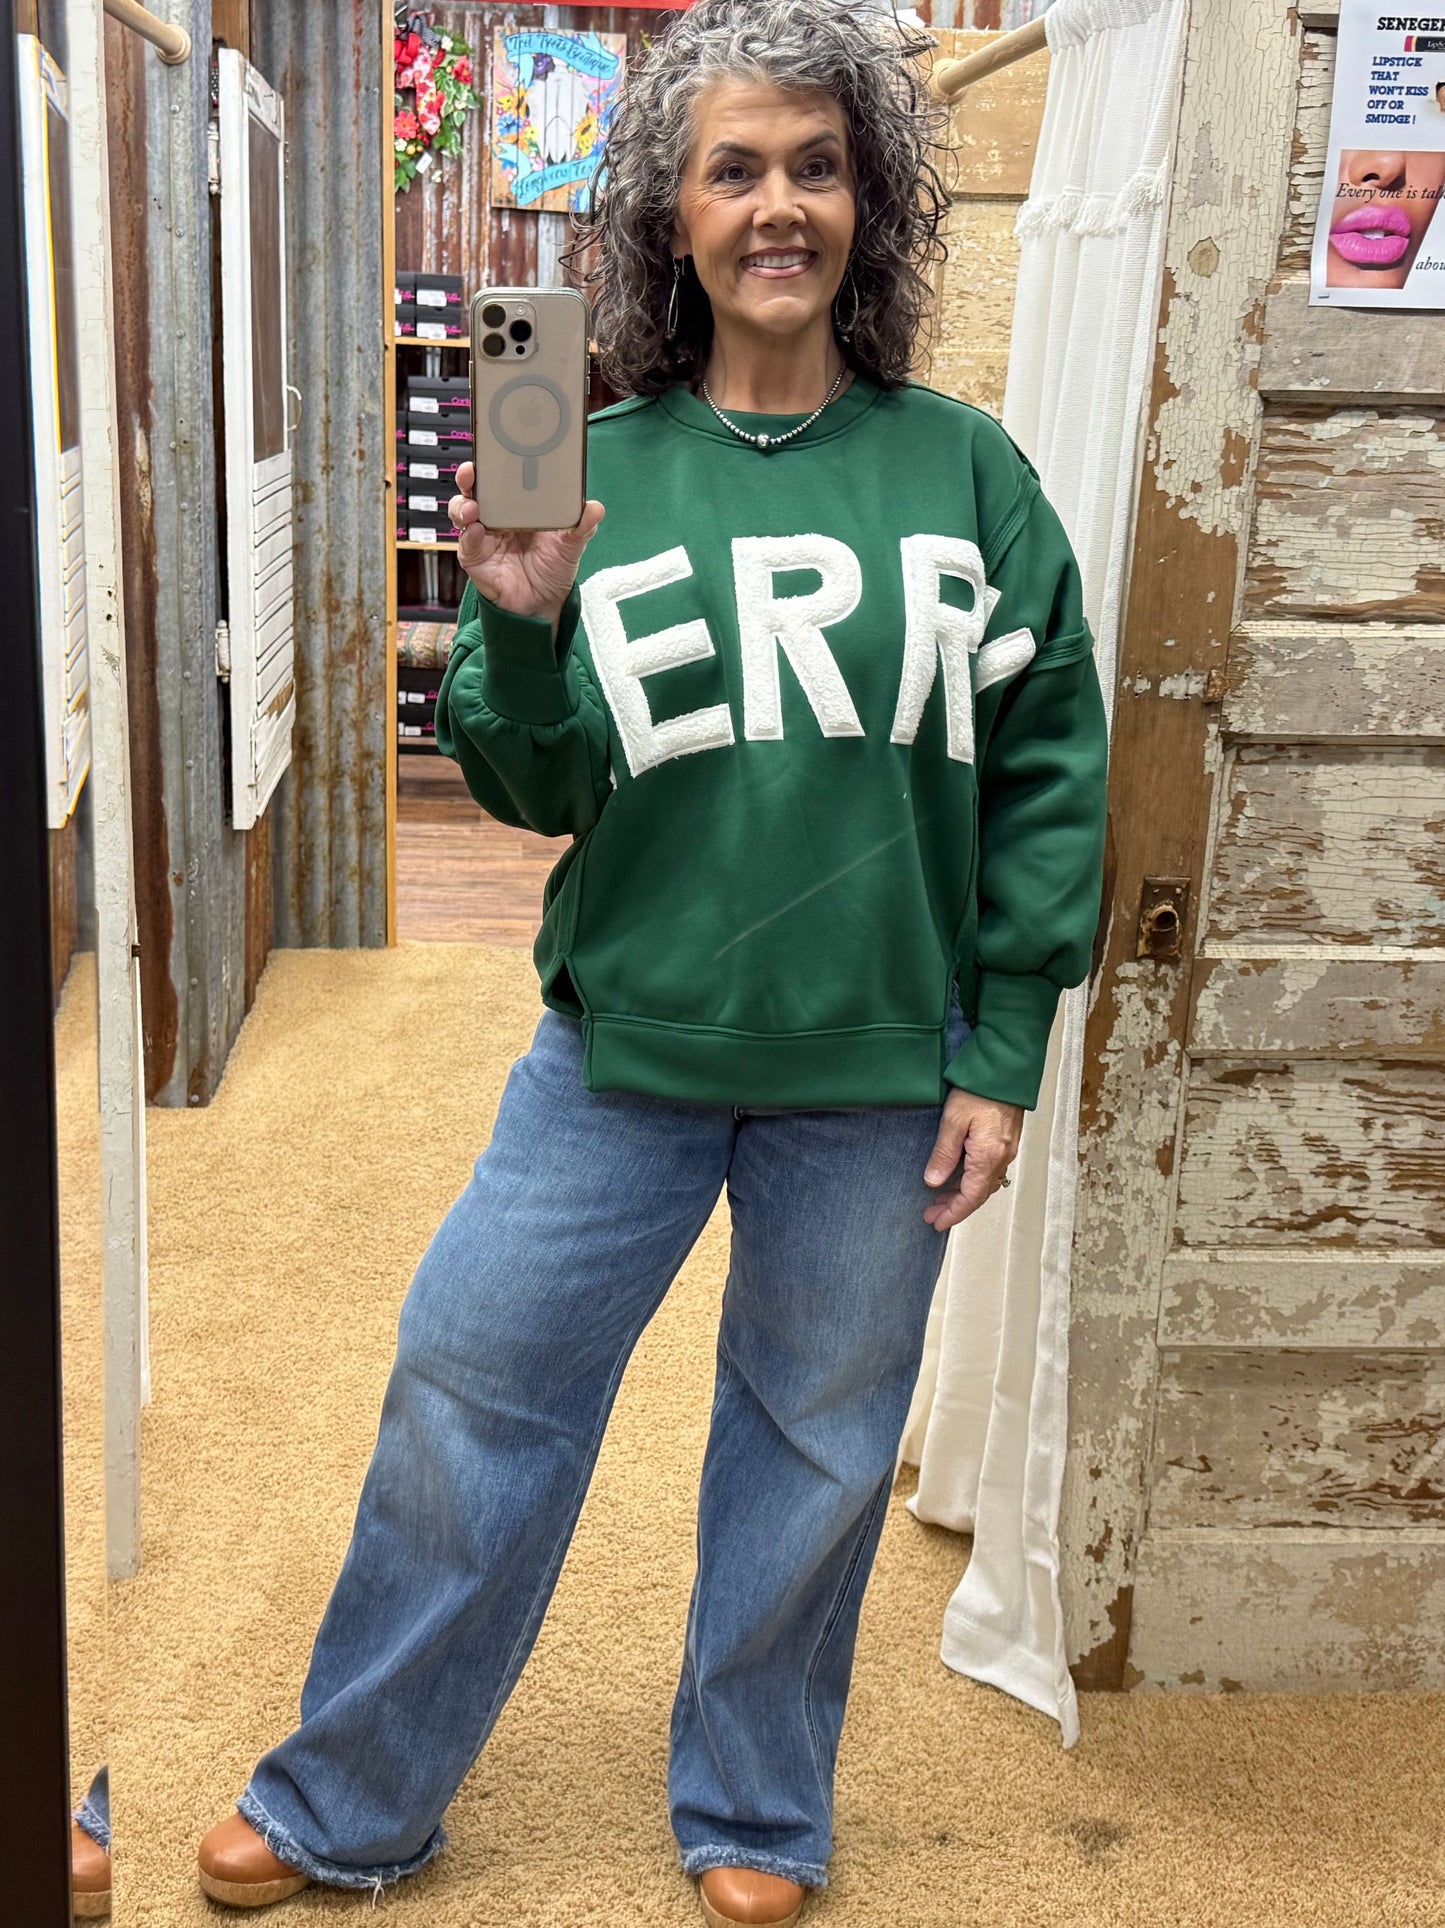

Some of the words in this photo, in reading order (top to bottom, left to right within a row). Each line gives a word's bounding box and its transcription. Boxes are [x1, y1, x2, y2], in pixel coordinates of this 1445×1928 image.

[1372, 56, 1422, 67] LIPSTICK
[1371, 71, 1399, 80] THAT
[1369, 85, 1403, 95] WON'T
[1405, 86, 1428, 96] KISS
[1367, 100, 1387, 109] OFF
[1388, 100, 1404, 109] OR
[1365, 114, 1410, 124] SMUDGE
[1336, 183, 1376, 203] Every
[1379, 188, 1403, 199] one
[1406, 185, 1418, 199] is
[579, 532, 1036, 790] ERR
